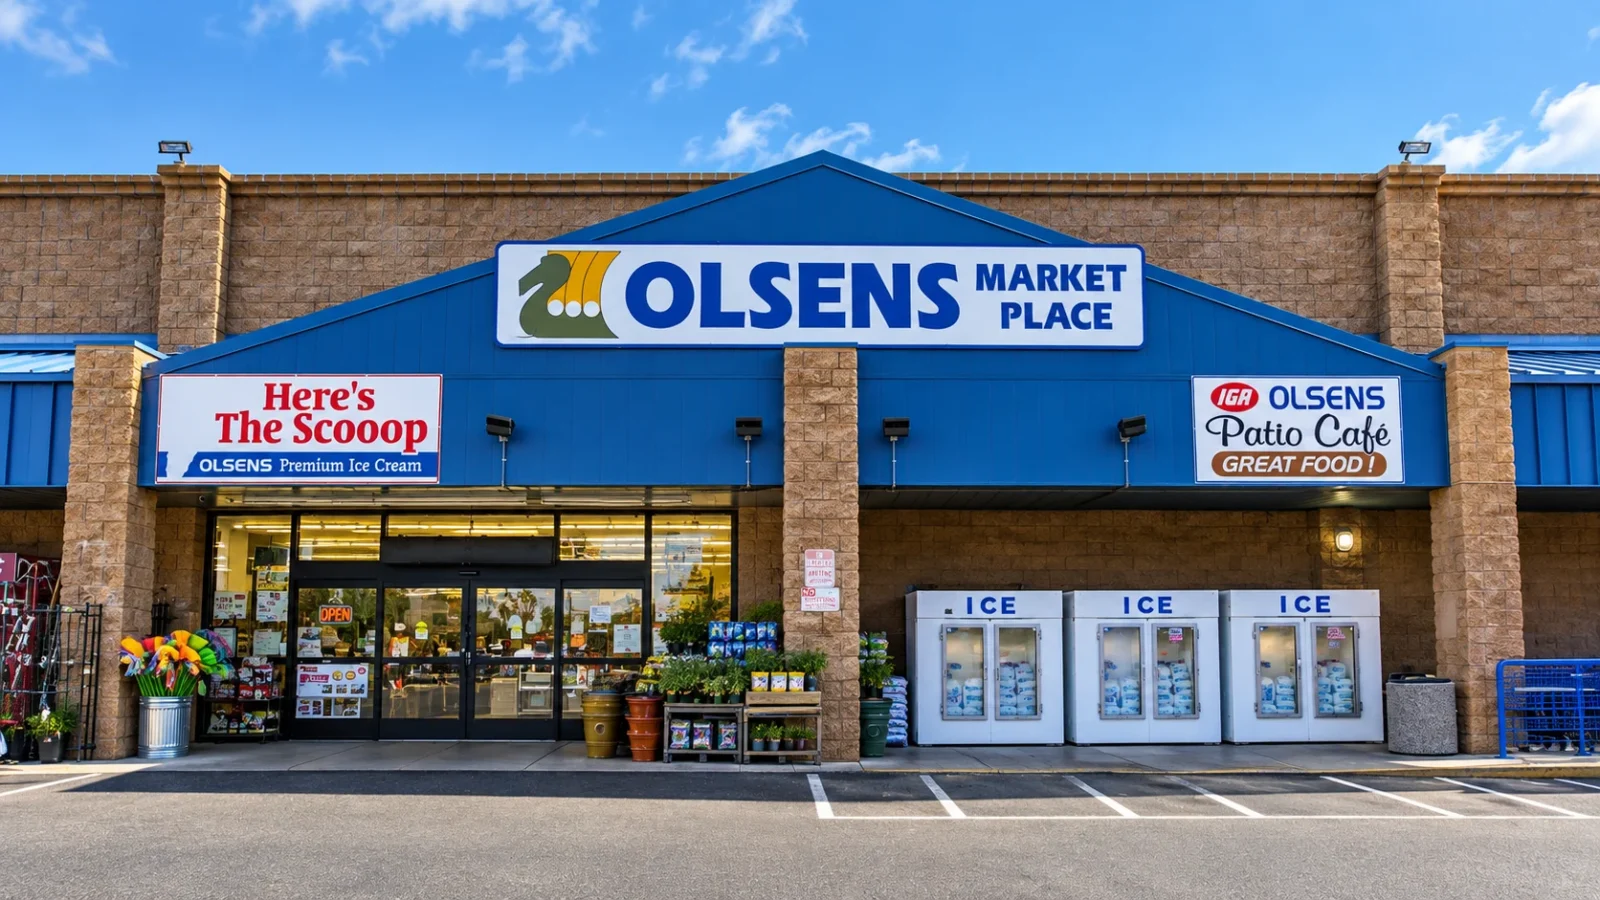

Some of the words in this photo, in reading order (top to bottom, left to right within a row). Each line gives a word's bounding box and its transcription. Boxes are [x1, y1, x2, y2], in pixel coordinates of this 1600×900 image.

[975, 264, 1127, 292] MARKET
[624, 261, 960, 330] OLSENS
[1000, 302, 1113, 330] PLACE
[263, 381, 375, 411] Here's
[1217, 388, 1253, 406] IGA
[1269, 385, 1385, 410] OLSENS
[215, 411, 283, 443] The
[293, 412, 428, 453] Scooop
[1205, 414, 1303, 447] Patio
[1314, 413, 1391, 455] Café
[199, 458, 272, 472] OLSENS
[279, 457, 345, 473] Premium
[348, 458, 369, 472] Ice
[374, 458, 422, 472] Cream
[1222, 455, 1296, 473] GREAT
[1300, 455, 1363, 473] FOOD
[321, 607, 350, 622] OPEN
[966, 596, 1016, 615] ICE
[1123, 596, 1173, 615] ICE
[1280, 595, 1331, 614] ICE
